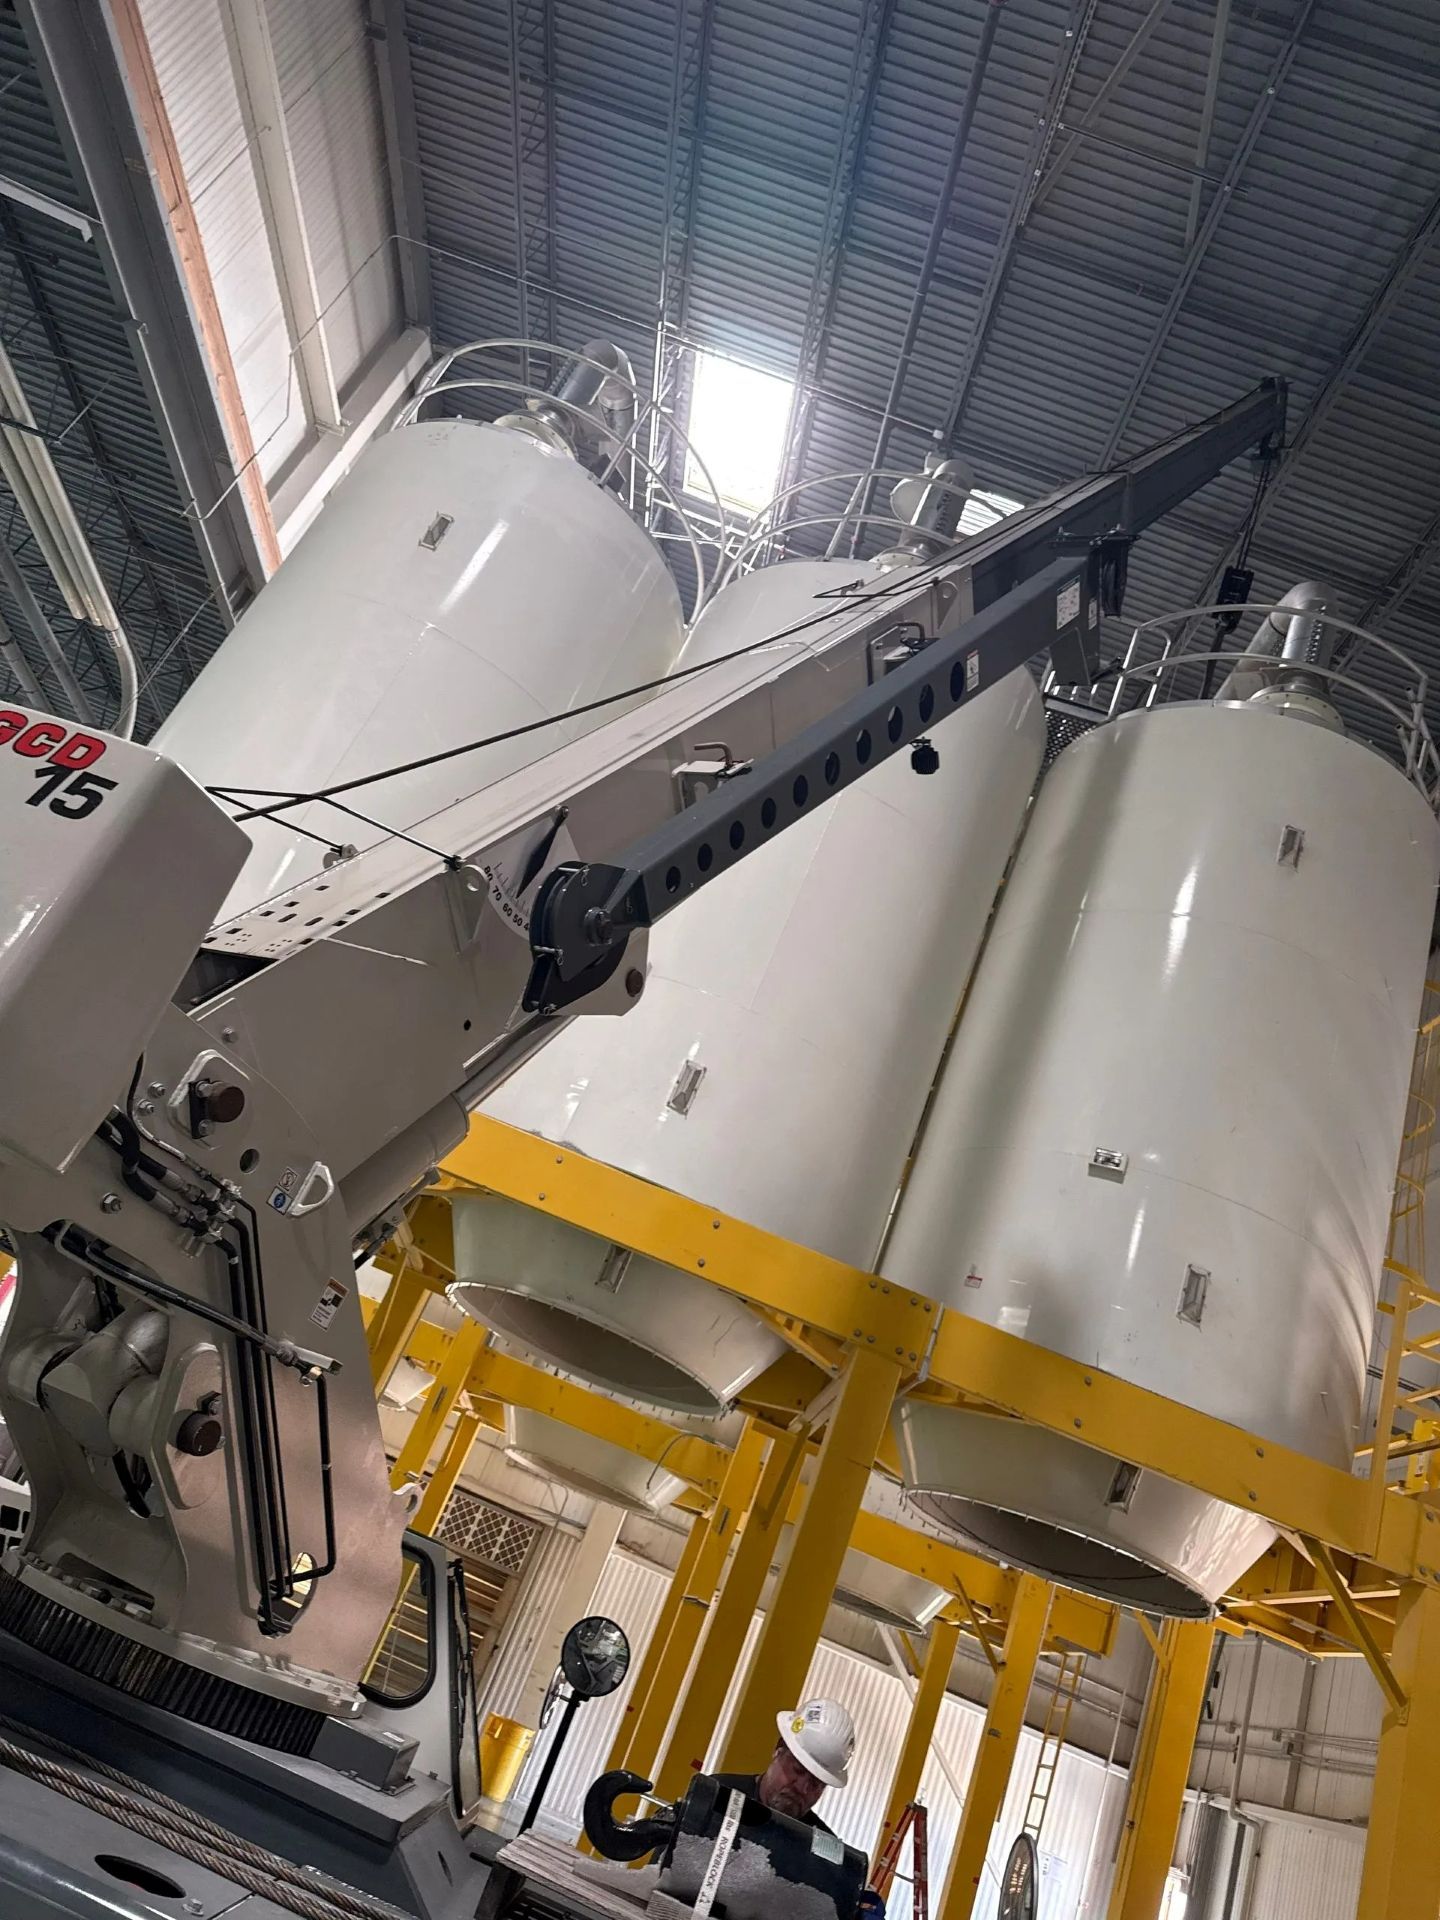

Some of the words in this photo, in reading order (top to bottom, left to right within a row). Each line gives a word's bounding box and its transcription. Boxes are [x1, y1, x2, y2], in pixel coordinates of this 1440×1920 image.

[24, 765, 119, 820] 15
[492, 885, 502, 901] 70
[502, 903, 513, 917] 60
[512, 914, 523, 927] 50
